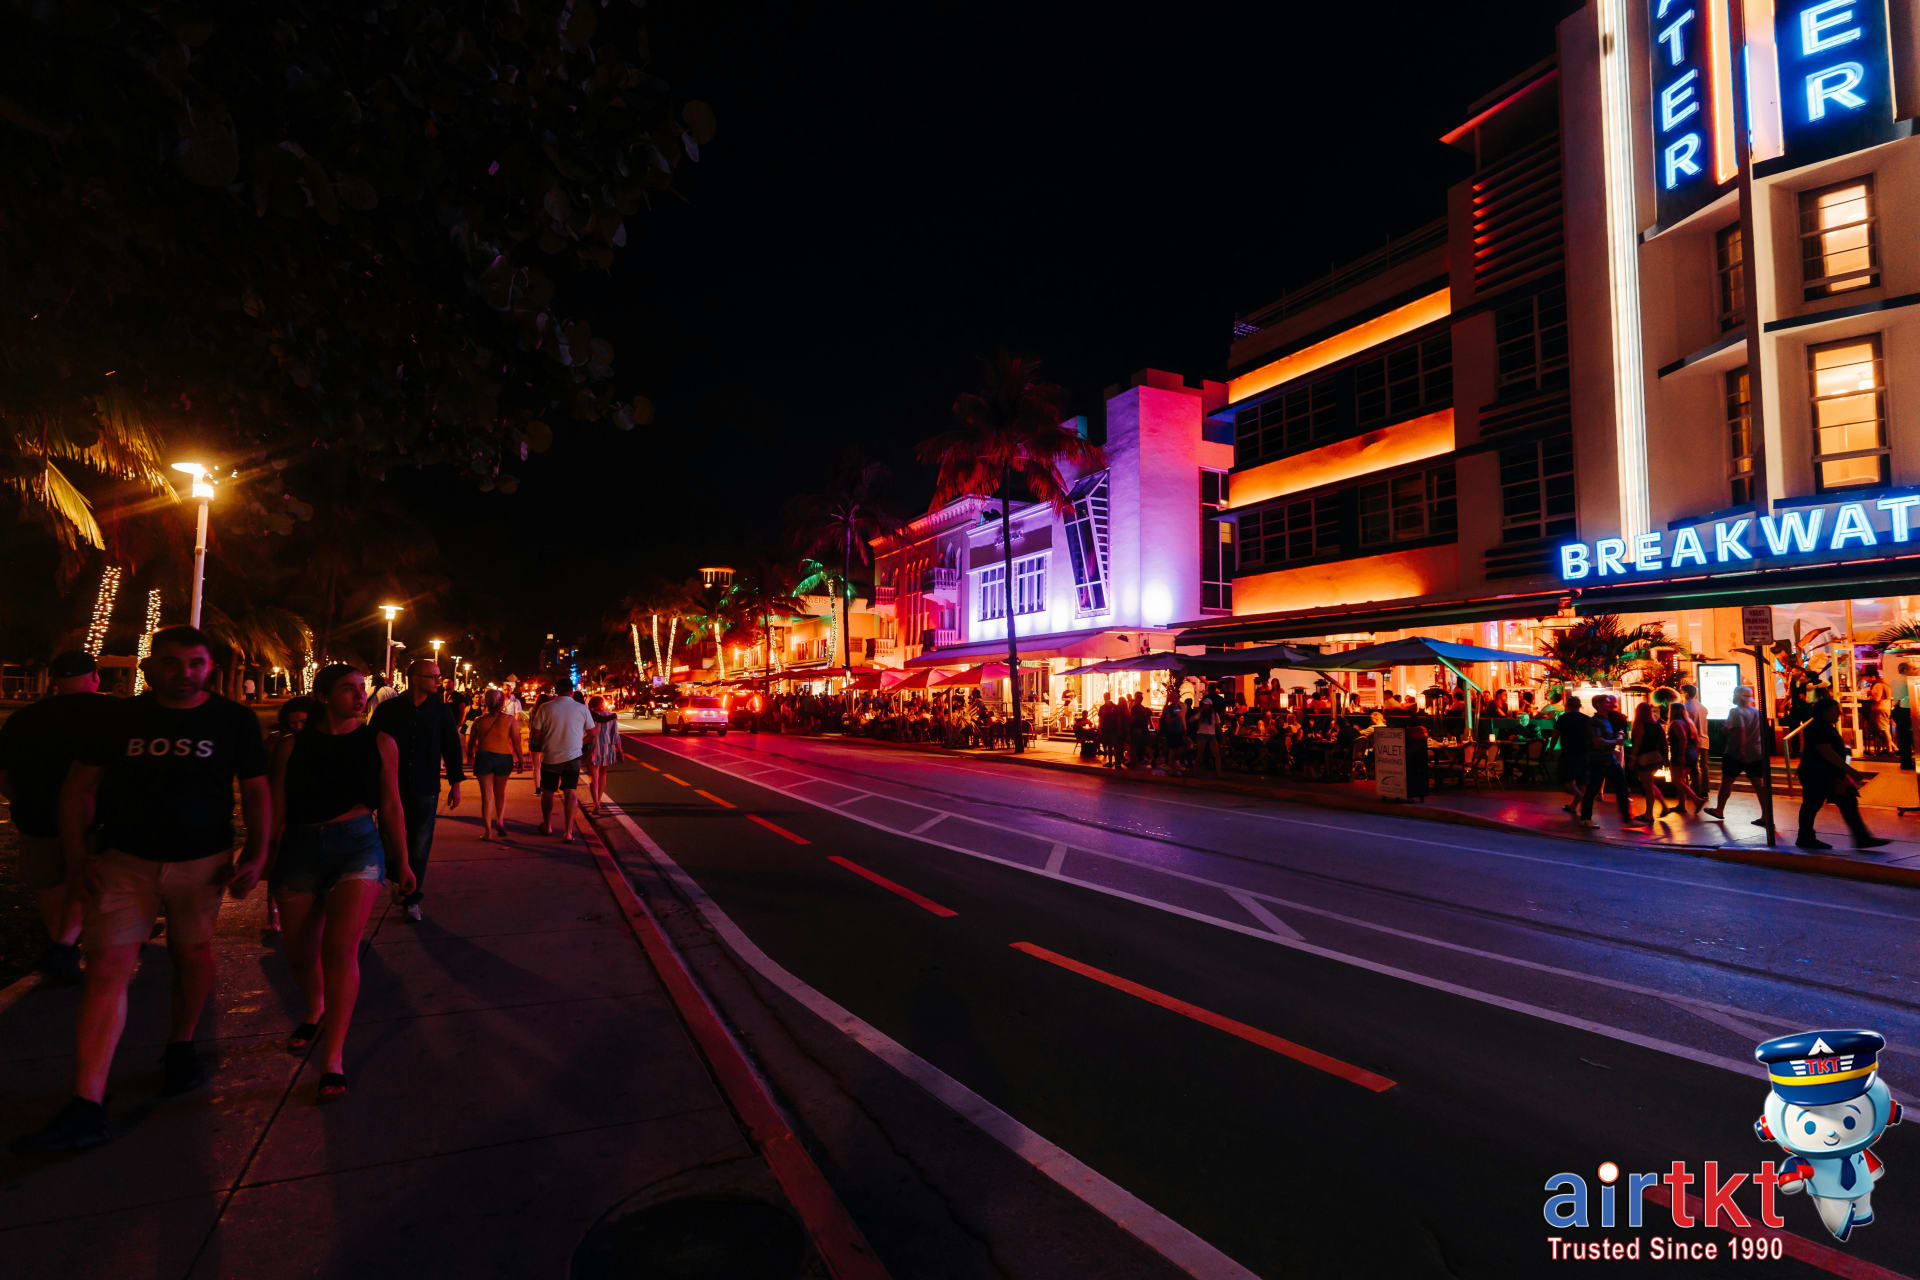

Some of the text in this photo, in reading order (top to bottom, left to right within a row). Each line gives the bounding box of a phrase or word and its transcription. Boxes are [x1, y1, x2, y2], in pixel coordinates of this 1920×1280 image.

[1800, 0, 1867, 123] ER
[1561, 494, 1920, 580] BREAKWAT
[126, 738, 214, 758] BOSS
[1376, 744, 1402, 756] VALET
